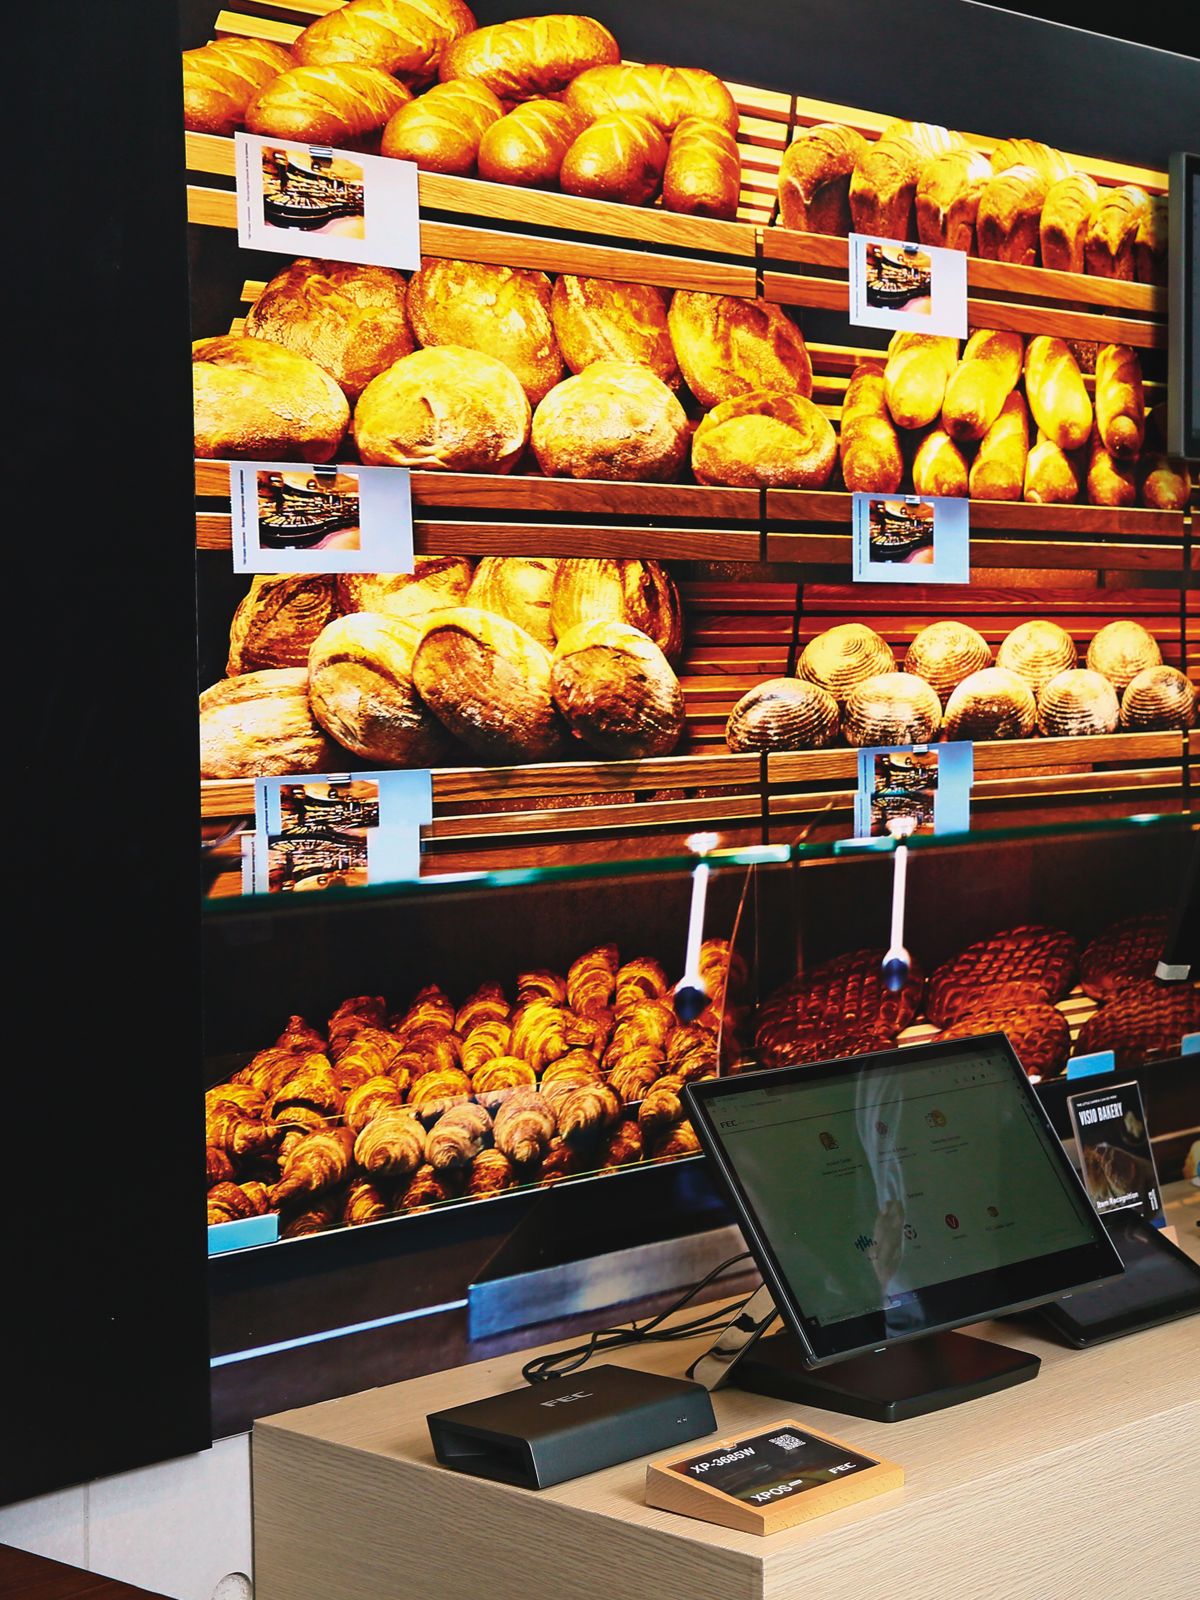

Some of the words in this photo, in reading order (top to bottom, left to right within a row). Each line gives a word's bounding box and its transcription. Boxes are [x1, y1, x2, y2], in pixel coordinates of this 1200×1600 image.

[1097, 1102, 1124, 1122] BAKERY
[720, 1119, 738, 1129] FEC
[540, 1391, 594, 1407] FEC
[690, 1446, 756, 1474] XP-3685W
[828, 1462, 857, 1475] FEC
[750, 1484, 794, 1503] XPOS
